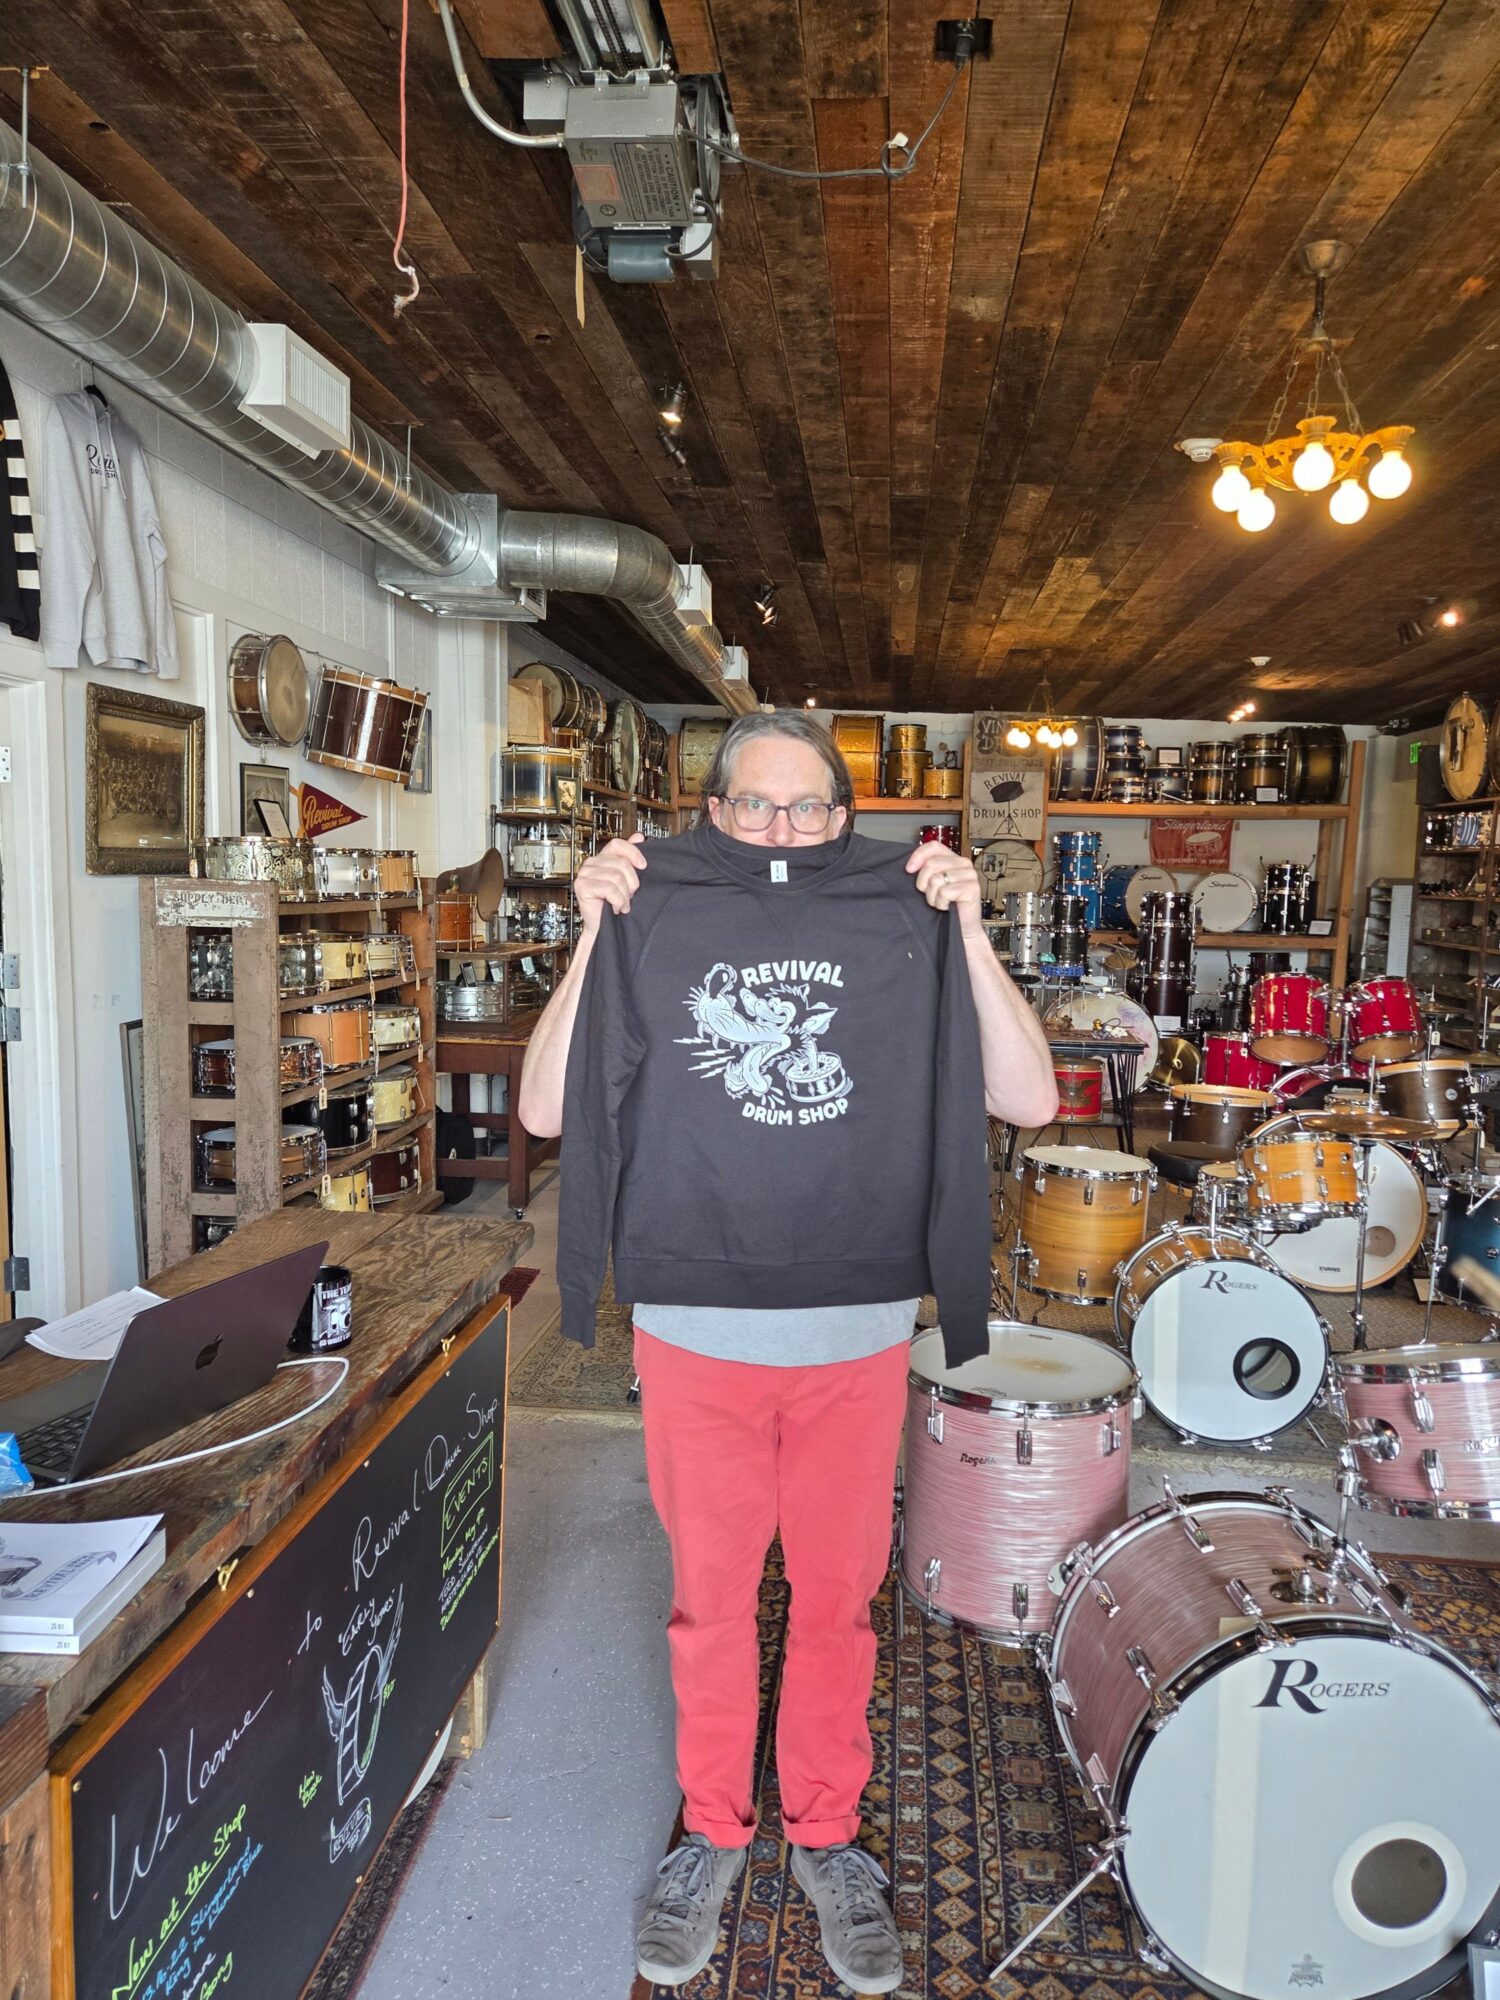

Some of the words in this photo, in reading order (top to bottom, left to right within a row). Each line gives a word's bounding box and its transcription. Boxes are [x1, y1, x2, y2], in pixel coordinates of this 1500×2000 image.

[666, 167, 680, 200] CAUTION
[984, 772, 1026, 790] REVIVAL
[303, 795, 344, 831] Revival
[321, 820, 338, 831] DRUM
[338, 815, 353, 826] SHOP
[973, 808, 1006, 819] DRUM
[1010, 808, 1042, 819] SHOP
[1157, 819, 1231, 834] Slingerland
[741, 960, 844, 988] REVIVAL
[742, 1102, 793, 1126] DRUM
[798, 1098, 849, 1126] SHOP
[1318, 1265, 1341, 1273] EVANS
[322, 1289, 339, 1300] THE
[960, 1452, 997, 1467] Rogers
[353, 1468, 420, 1592] Revival
[466, 1392, 498, 1440] Shop
[444, 1456, 489, 1530] EVENTS
[298, 1610, 322, 1655] to
[112, 1936, 153, 2000] New
[160, 1897, 180, 1940] at
[185, 1860, 212, 1896] the
[213, 1803, 247, 1857] Shop
[193, 1935, 206, 1953] in
[243, 1842, 264, 1879] Blue
